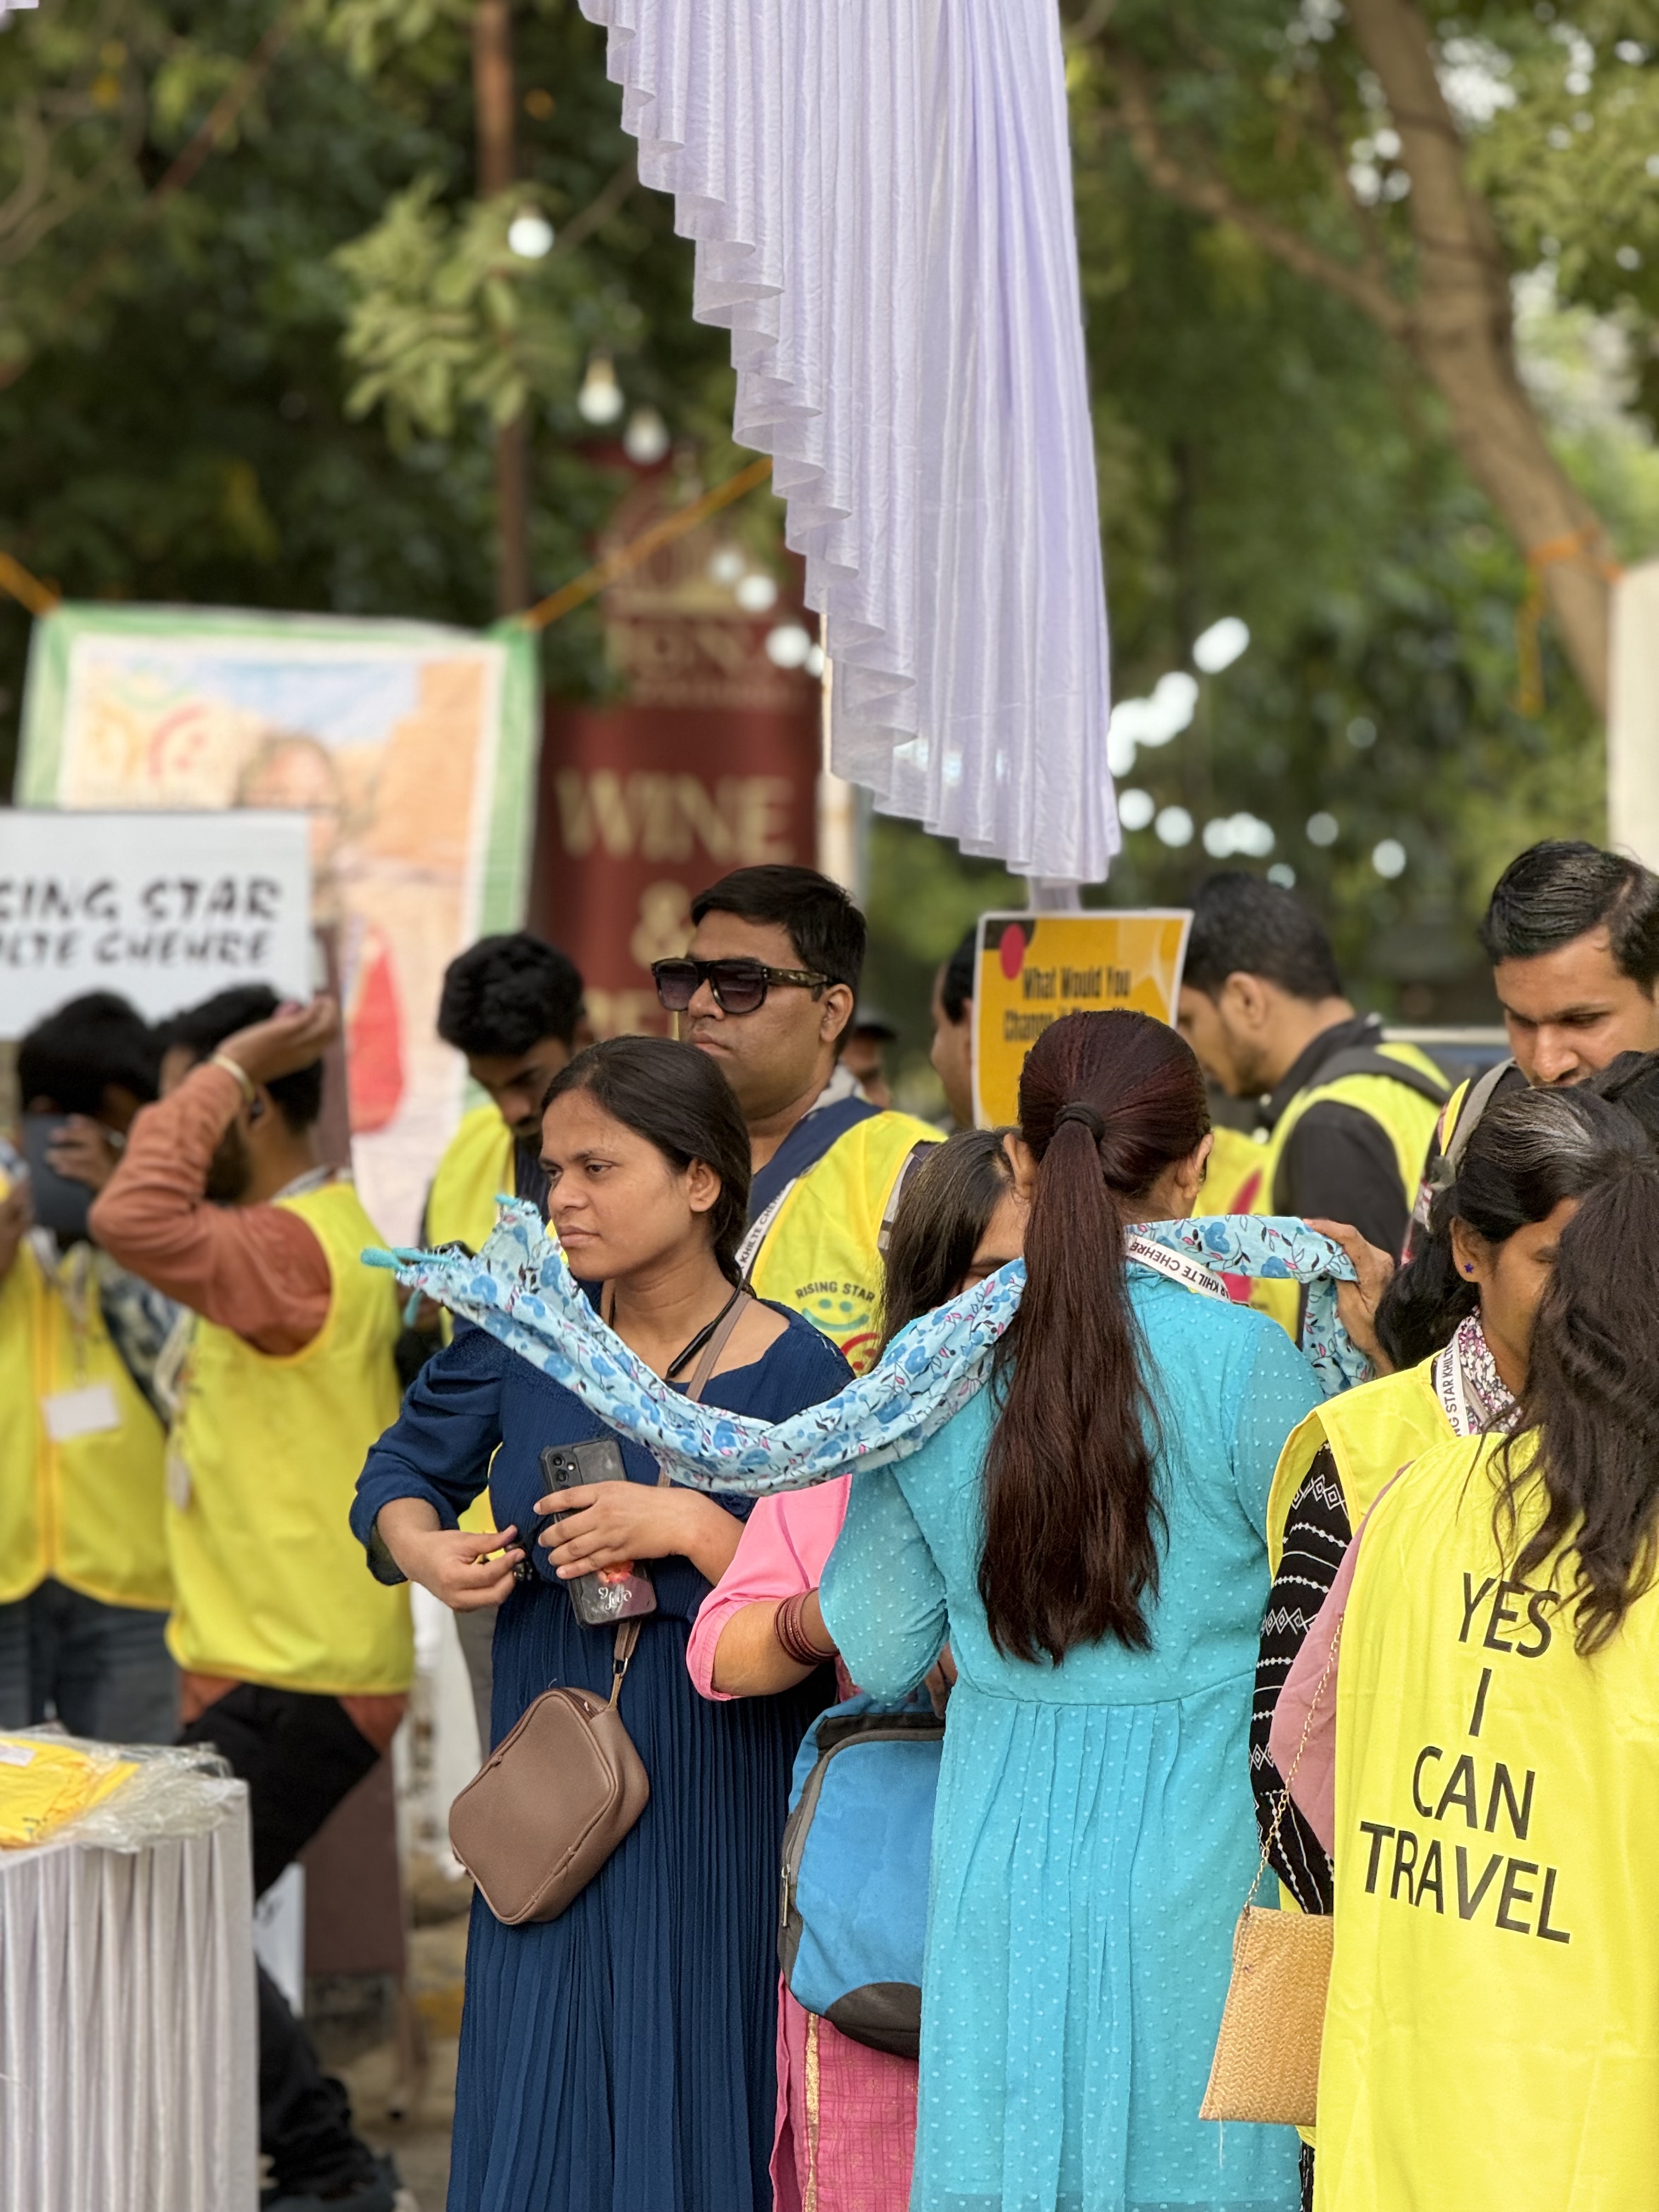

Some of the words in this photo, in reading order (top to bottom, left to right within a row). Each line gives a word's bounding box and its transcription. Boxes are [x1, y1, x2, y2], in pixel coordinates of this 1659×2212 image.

[555, 772, 795, 862] WINE
[142, 878, 281, 920] STAR
[0, 930, 80, 968] LTE
[740, 1227, 762, 1263] KHILTE
[1130, 1242, 1180, 1271] CHEHRE
[795, 1281, 837, 1299] RISING
[843, 1283, 876, 1302] STAR
[1182, 1266, 1219, 1292] KHILTE
[1443, 1379, 1457, 1413] STAR
[1458, 1572, 1561, 1658] YES
[1469, 1668, 1492, 1737] I
[1413, 1746, 1536, 1840] CAN
[1360, 1821, 1571, 1944] TRAVEL
